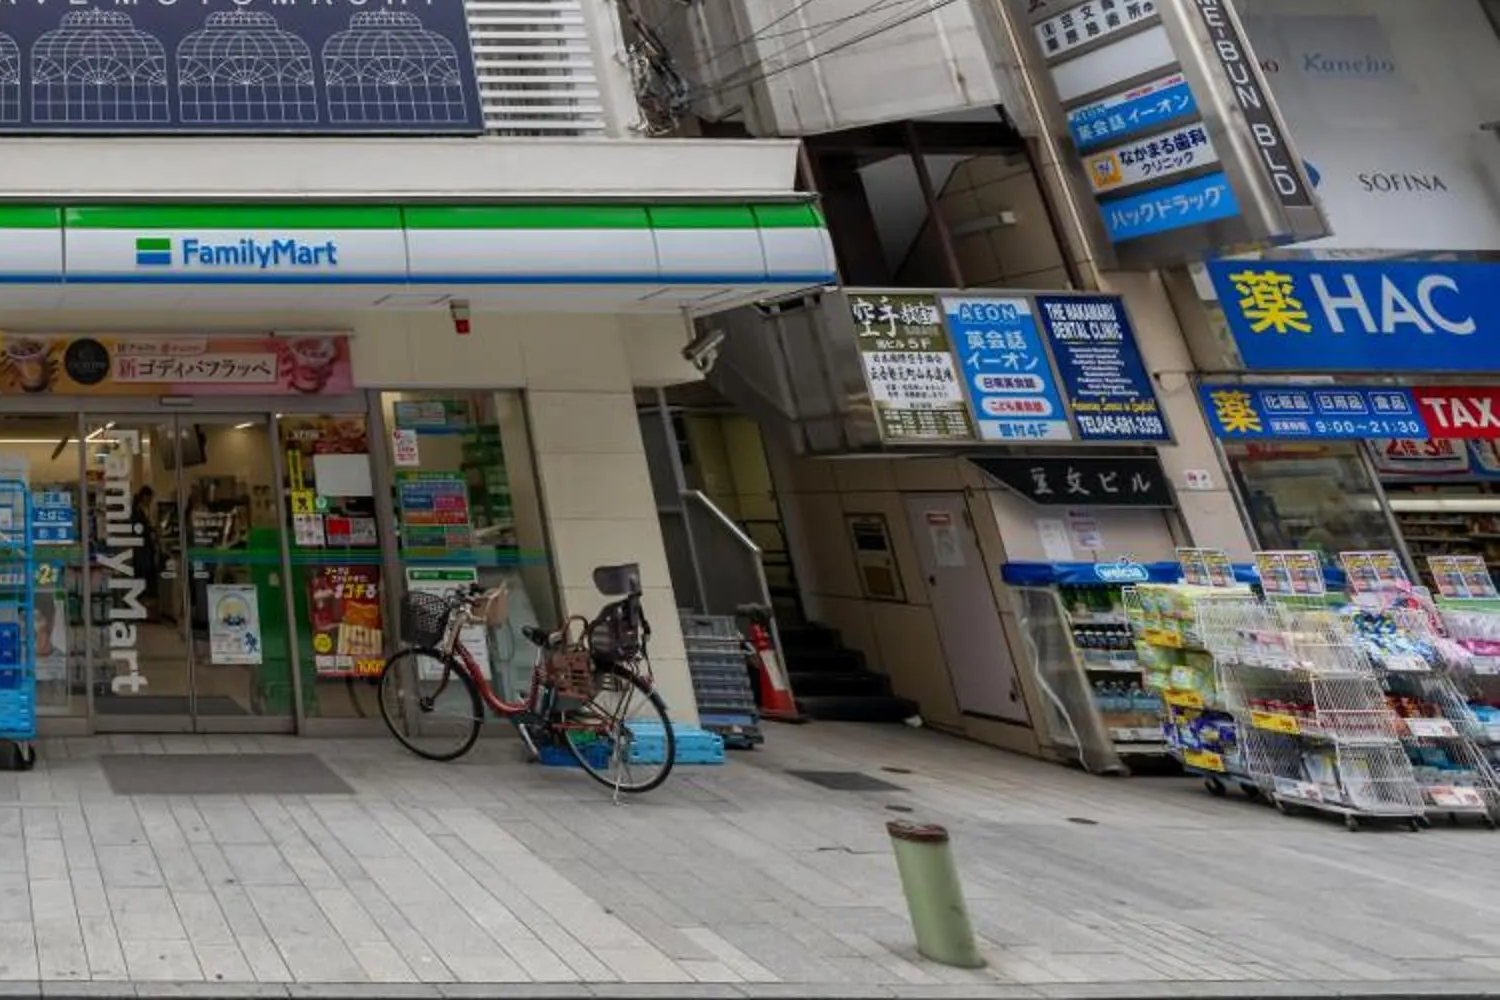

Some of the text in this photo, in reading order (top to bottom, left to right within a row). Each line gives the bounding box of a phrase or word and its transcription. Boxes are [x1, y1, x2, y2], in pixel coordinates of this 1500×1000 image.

[1303, 53, 1396, 73] Kanebo
[1119, 127, 1208, 166] なかまる歯科
[1252, 122, 1297, 195] BLD
[1141, 151, 1195, 176] クリニック
[1358, 172, 1448, 193] SOFINA
[1110, 184, 1228, 231] ハックドラッグ
[182, 238, 338, 269] FamilyMart
[852, 296, 899, 338] 空手
[958, 303, 1018, 322] AEON
[1044, 303, 1067, 320] THE
[1229, 270, 1476, 335] 薬 HAC
[964, 331, 1027, 349] 英会話
[966, 351, 1039, 370] イーオン
[1210, 390, 1263, 432] 薬
[1318, 395, 1363, 409] 日用品
[1421, 397, 1500, 429] TAX
[98, 429, 148, 694] FamilyMart
